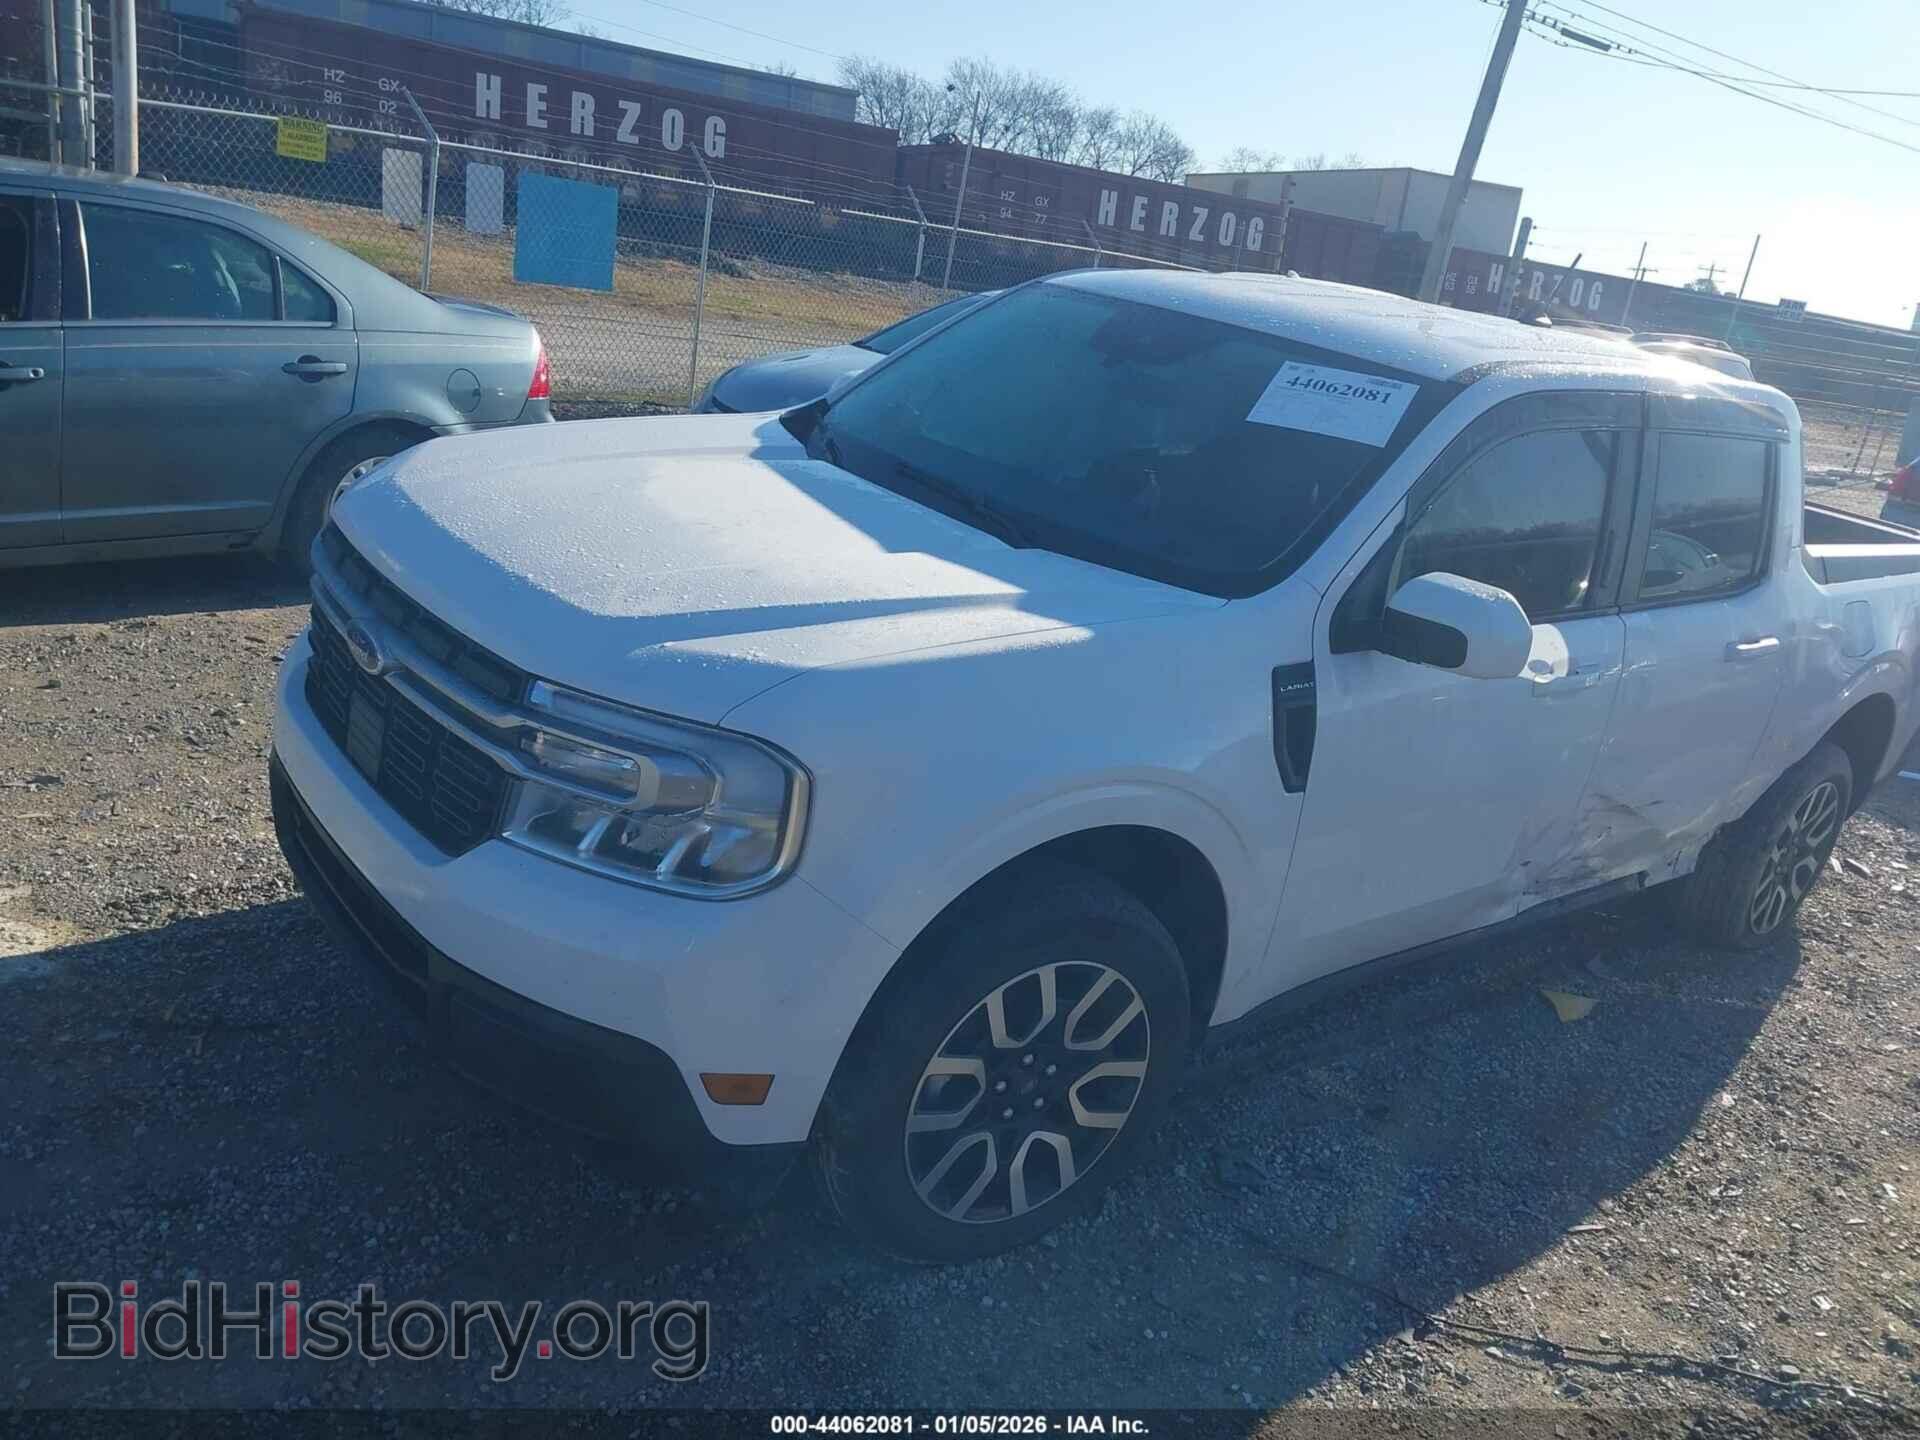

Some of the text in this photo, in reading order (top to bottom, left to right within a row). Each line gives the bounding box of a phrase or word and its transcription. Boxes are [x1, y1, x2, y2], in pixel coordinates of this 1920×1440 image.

[324, 67, 400, 92] HZ GX
[323, 88, 342, 105] 96
[475, 72, 727, 159] HERZOG
[1000, 189, 1050, 208] HZ GX
[1098, 189, 1265, 251] HERZOG
[1286, 375, 1392, 404] 44062081
